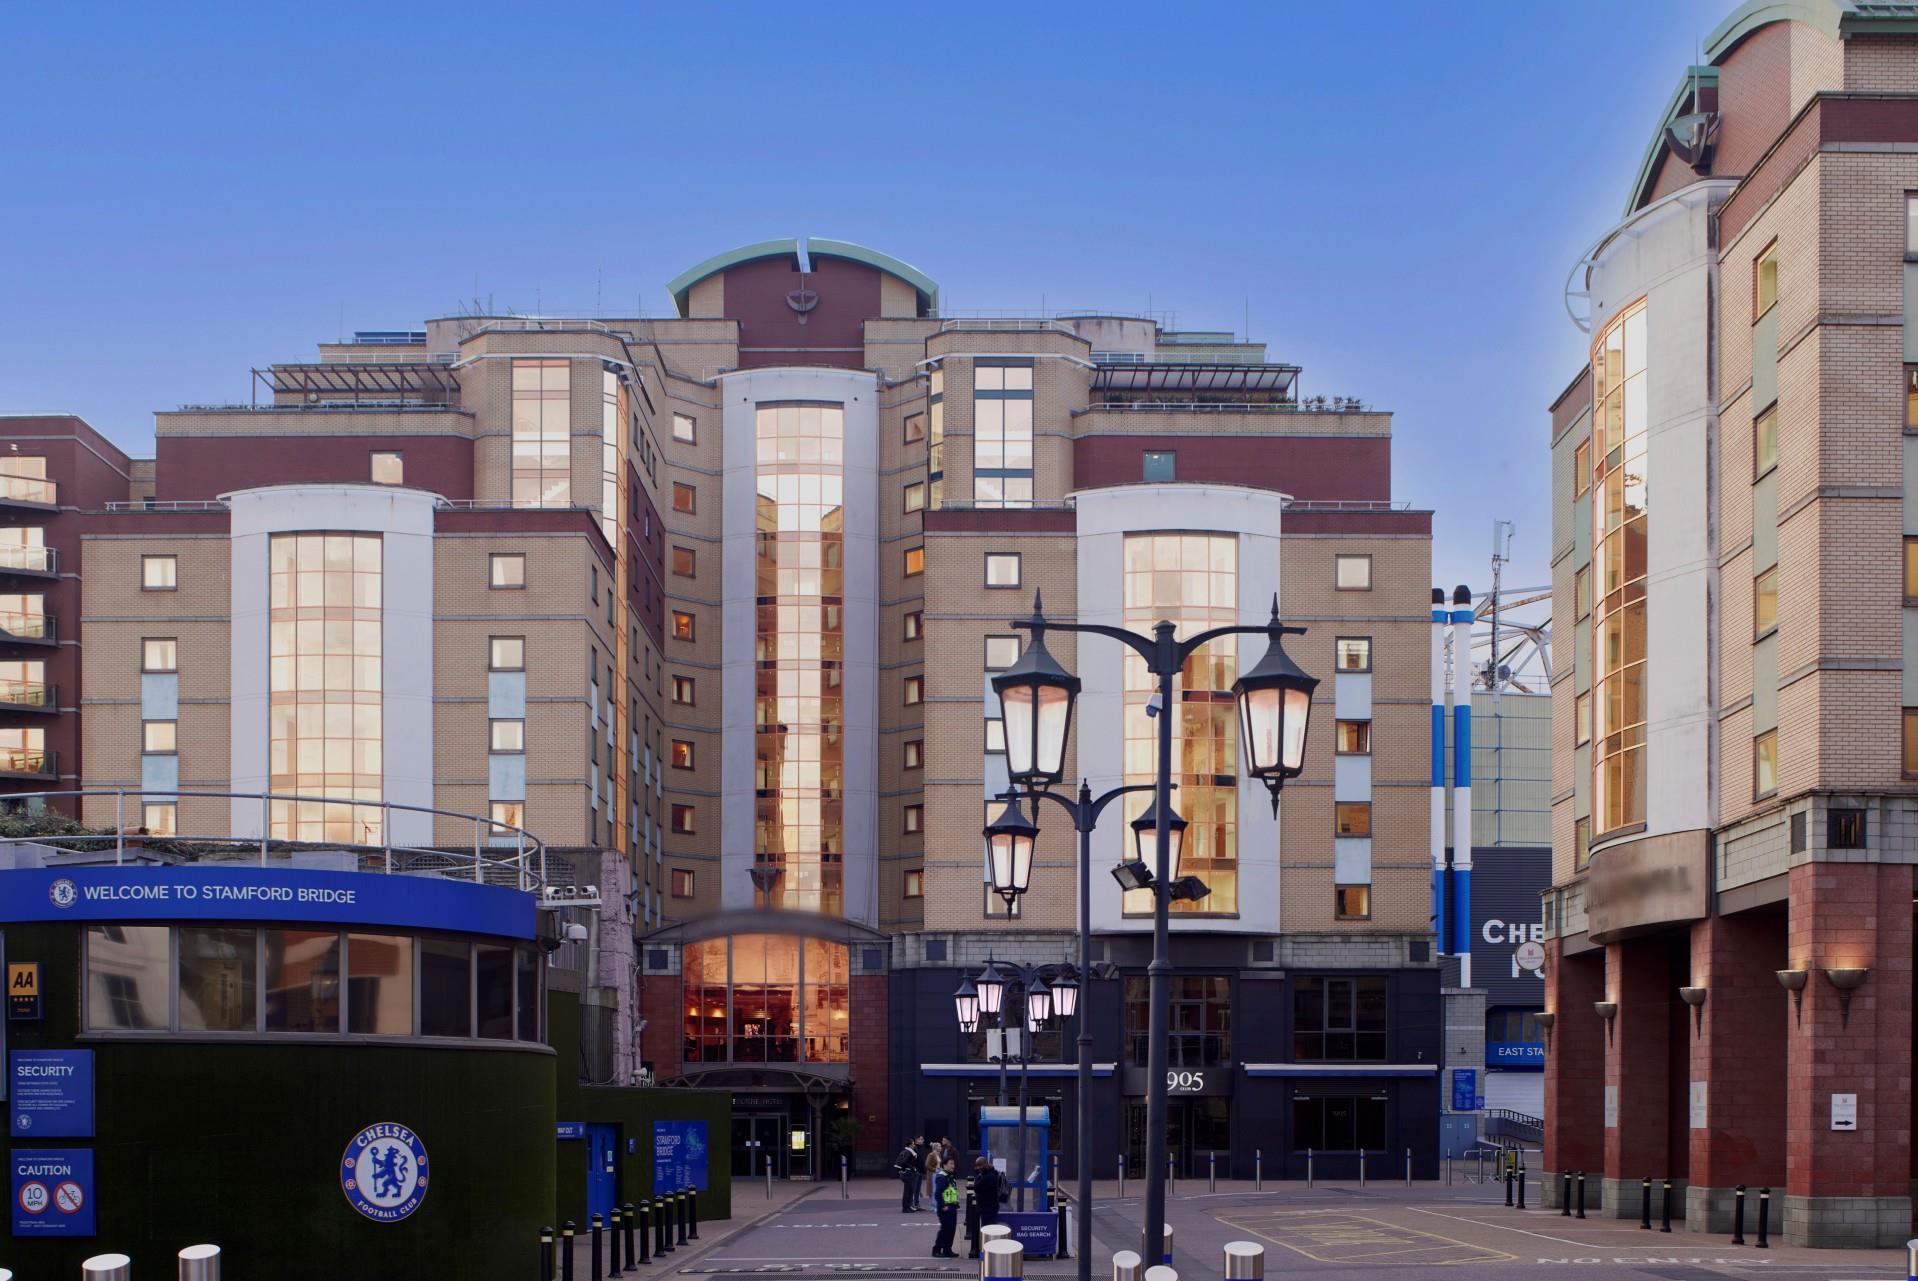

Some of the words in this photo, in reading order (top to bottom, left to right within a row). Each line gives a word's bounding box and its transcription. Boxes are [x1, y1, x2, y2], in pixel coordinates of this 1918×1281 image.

[83, 885, 169, 900] WELCOME
[173, 885, 197, 899] TO
[202, 885, 293, 901] STAMFORD
[298, 888, 356, 904] BRIDGE
[13, 971, 33, 988] AA
[1498, 1047, 1524, 1056] EAST
[1526, 1047, 1544, 1056] STA
[17, 1066, 74, 1076] SECURITY
[356, 1125, 415, 1147] CHELSEA
[656, 1135, 681, 1145] STAMFORD
[656, 1146, 674, 1156] BRIDGE
[18, 1165, 71, 1175] CAUTION
[27, 1187, 43, 1200] 10
[356, 1200, 398, 1217] FOOTBALL
[399, 1198, 417, 1214] CLUB
